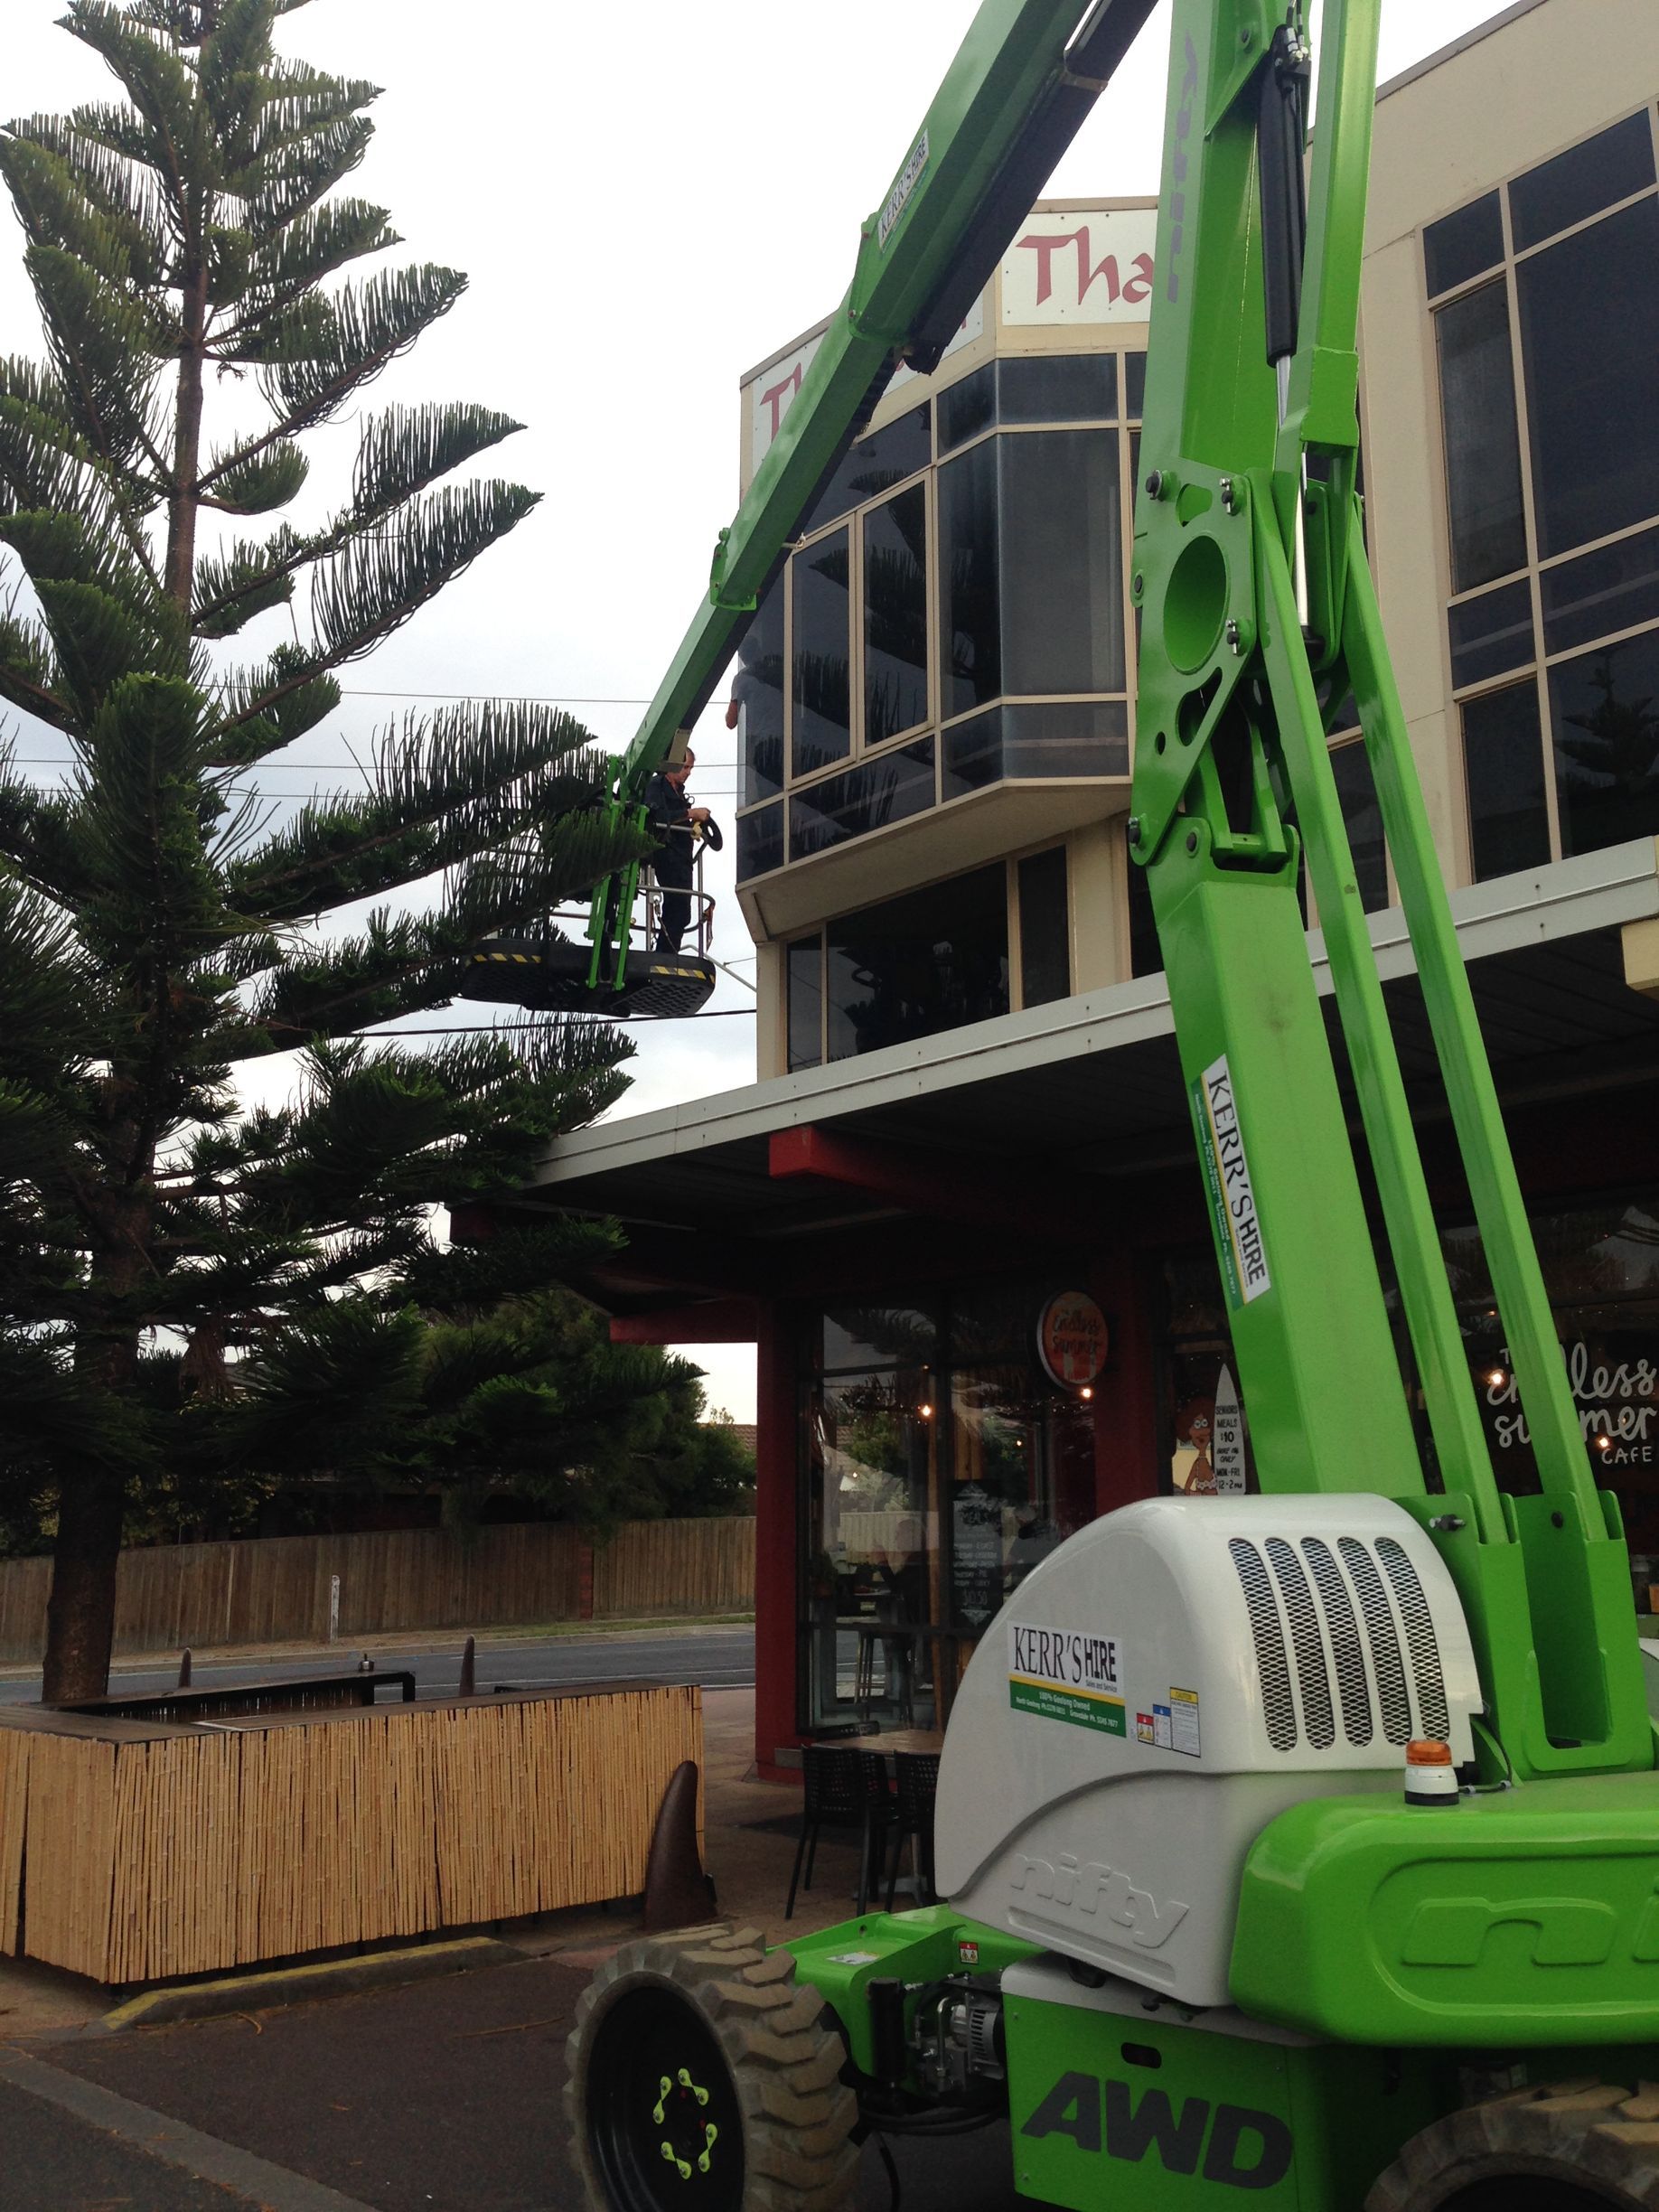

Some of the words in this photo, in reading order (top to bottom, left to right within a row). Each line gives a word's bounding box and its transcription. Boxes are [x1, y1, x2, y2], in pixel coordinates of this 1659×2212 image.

[1207, 1070, 1253, 1219] KERR'S
[1239, 1216, 1266, 1286] HIRE
[1215, 1405, 1238, 1415] SENIORS
[1216, 1419, 1238, 1428] MEALS
[1221, 1430, 1235, 1443] $10
[1601, 1446, 1653, 1465] CAFE
[1014, 1626, 1082, 1683] KERR'S
[1083, 1638, 1117, 1682] HIRE
[1010, 1852, 1190, 1949] nifty
[1020, 2070, 1293, 2189] AWD
